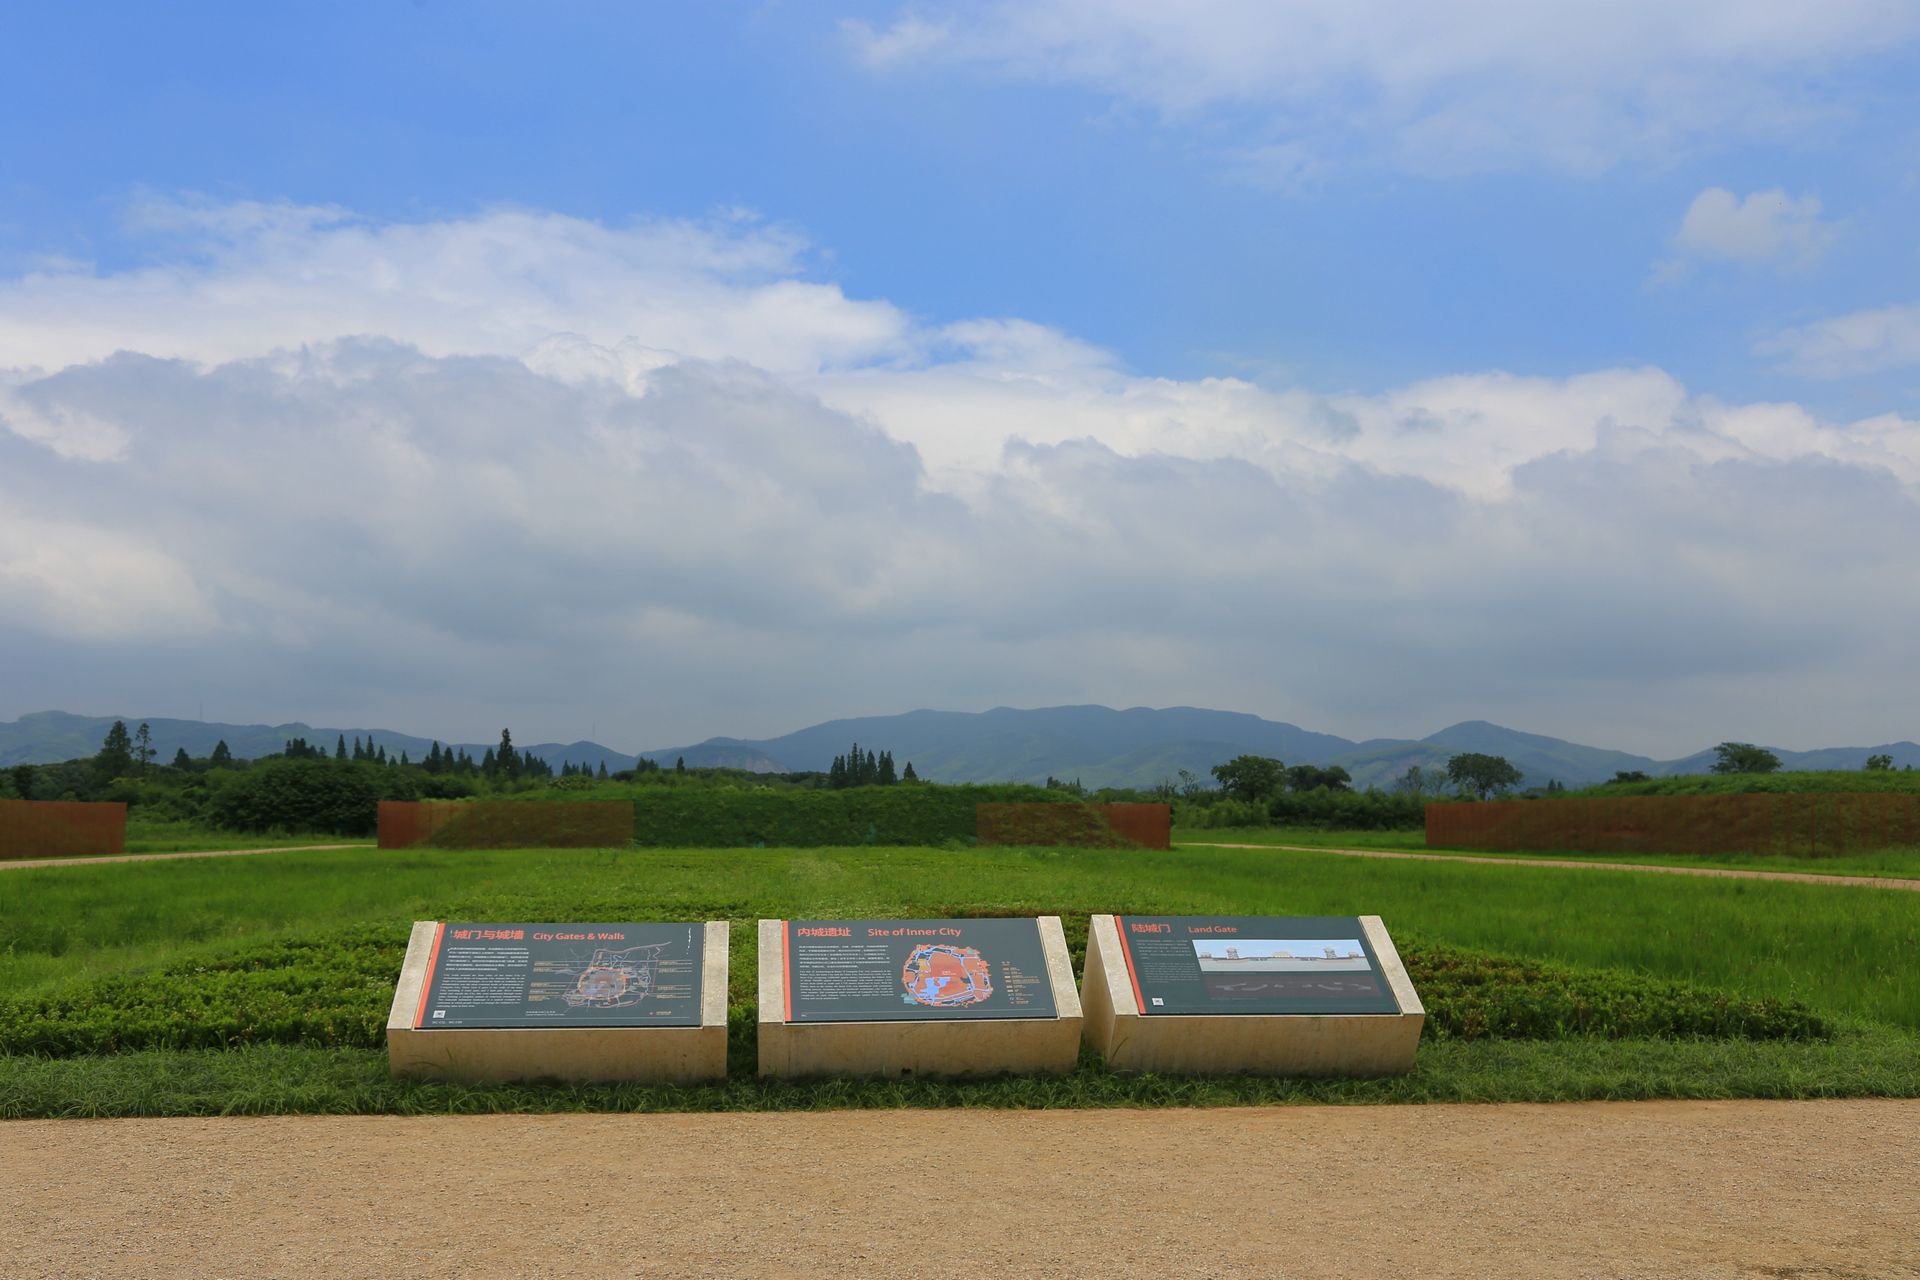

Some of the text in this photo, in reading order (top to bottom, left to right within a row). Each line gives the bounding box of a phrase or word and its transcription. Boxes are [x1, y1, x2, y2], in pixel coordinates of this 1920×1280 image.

[533, 932, 625, 941] City Gates & Walls
[867, 928, 962, 937] Site of Inner City
